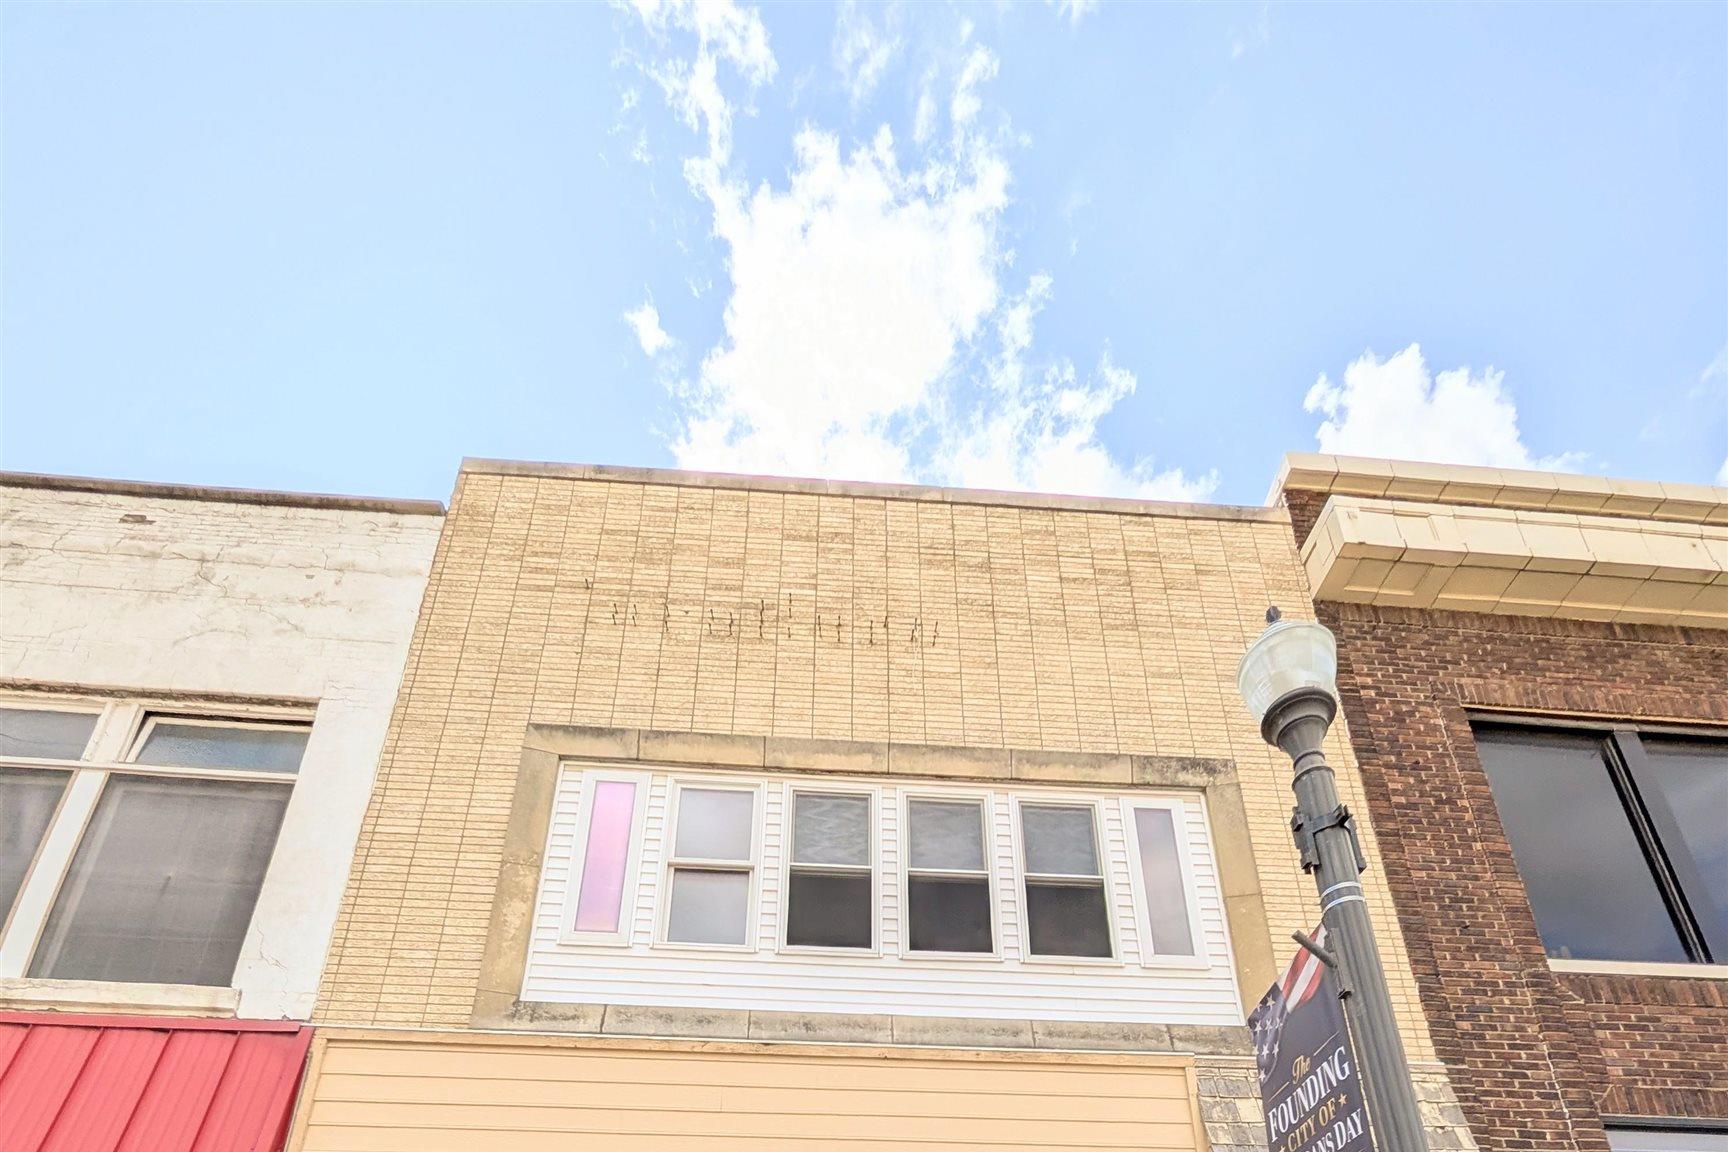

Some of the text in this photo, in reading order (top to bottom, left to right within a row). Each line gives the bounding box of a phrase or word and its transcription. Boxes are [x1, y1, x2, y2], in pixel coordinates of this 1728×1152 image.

[1268, 1045, 1351, 1143] FOUNDING
[1292, 1055, 1311, 1085] The
[1287, 1098, 1337, 1152] CITY OF
[1333, 1108, 1364, 1151] DAY
